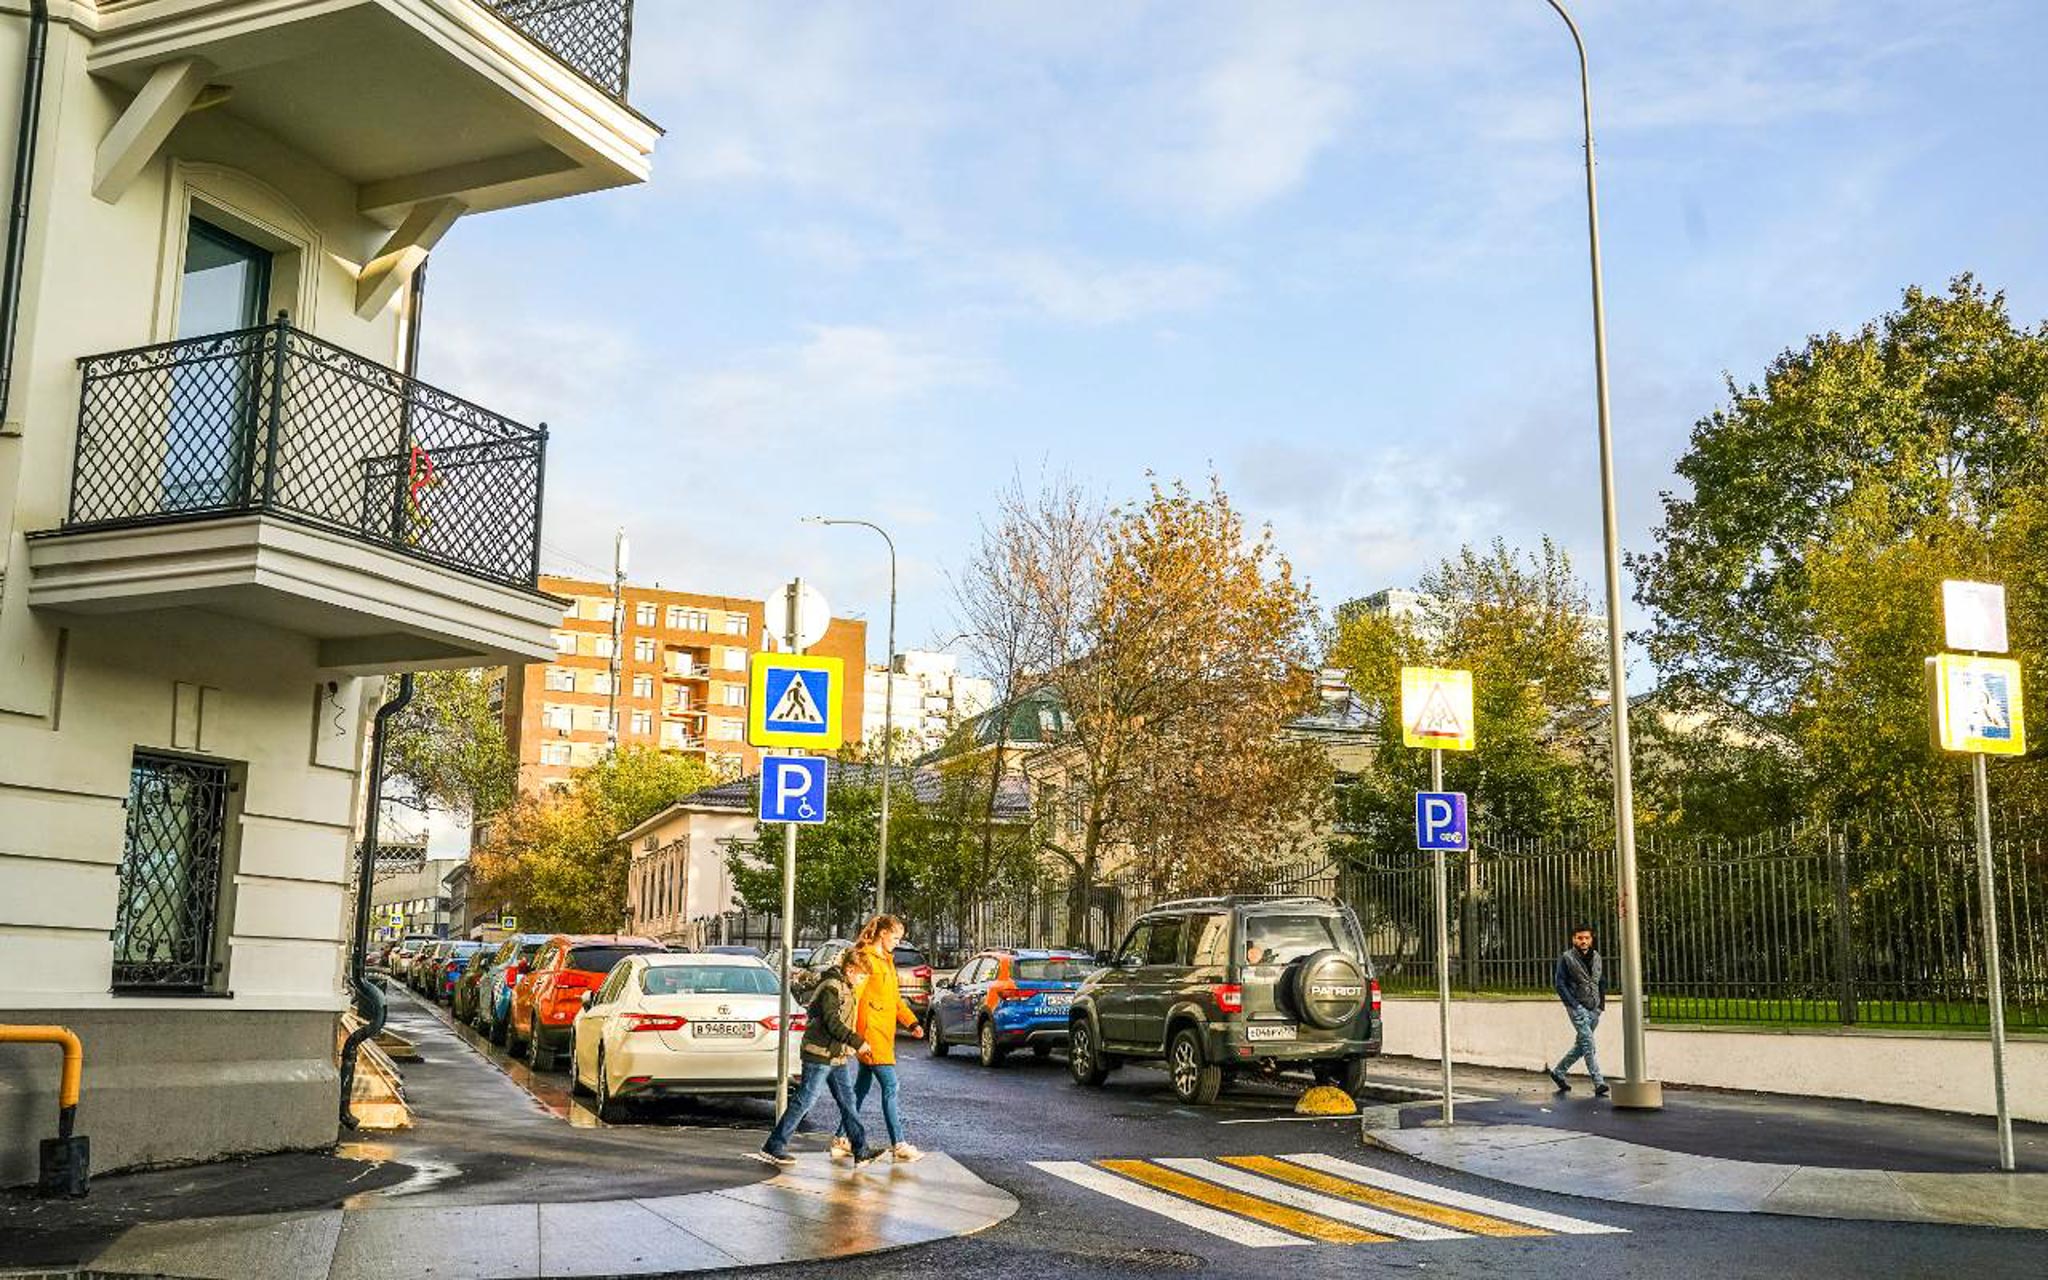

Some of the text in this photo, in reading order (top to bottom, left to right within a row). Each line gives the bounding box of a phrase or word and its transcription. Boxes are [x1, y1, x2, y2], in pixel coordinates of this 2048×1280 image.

[777, 764, 812, 815] P
[1425, 799, 1452, 842] P
[1311, 986, 1362, 996] PATRIOT
